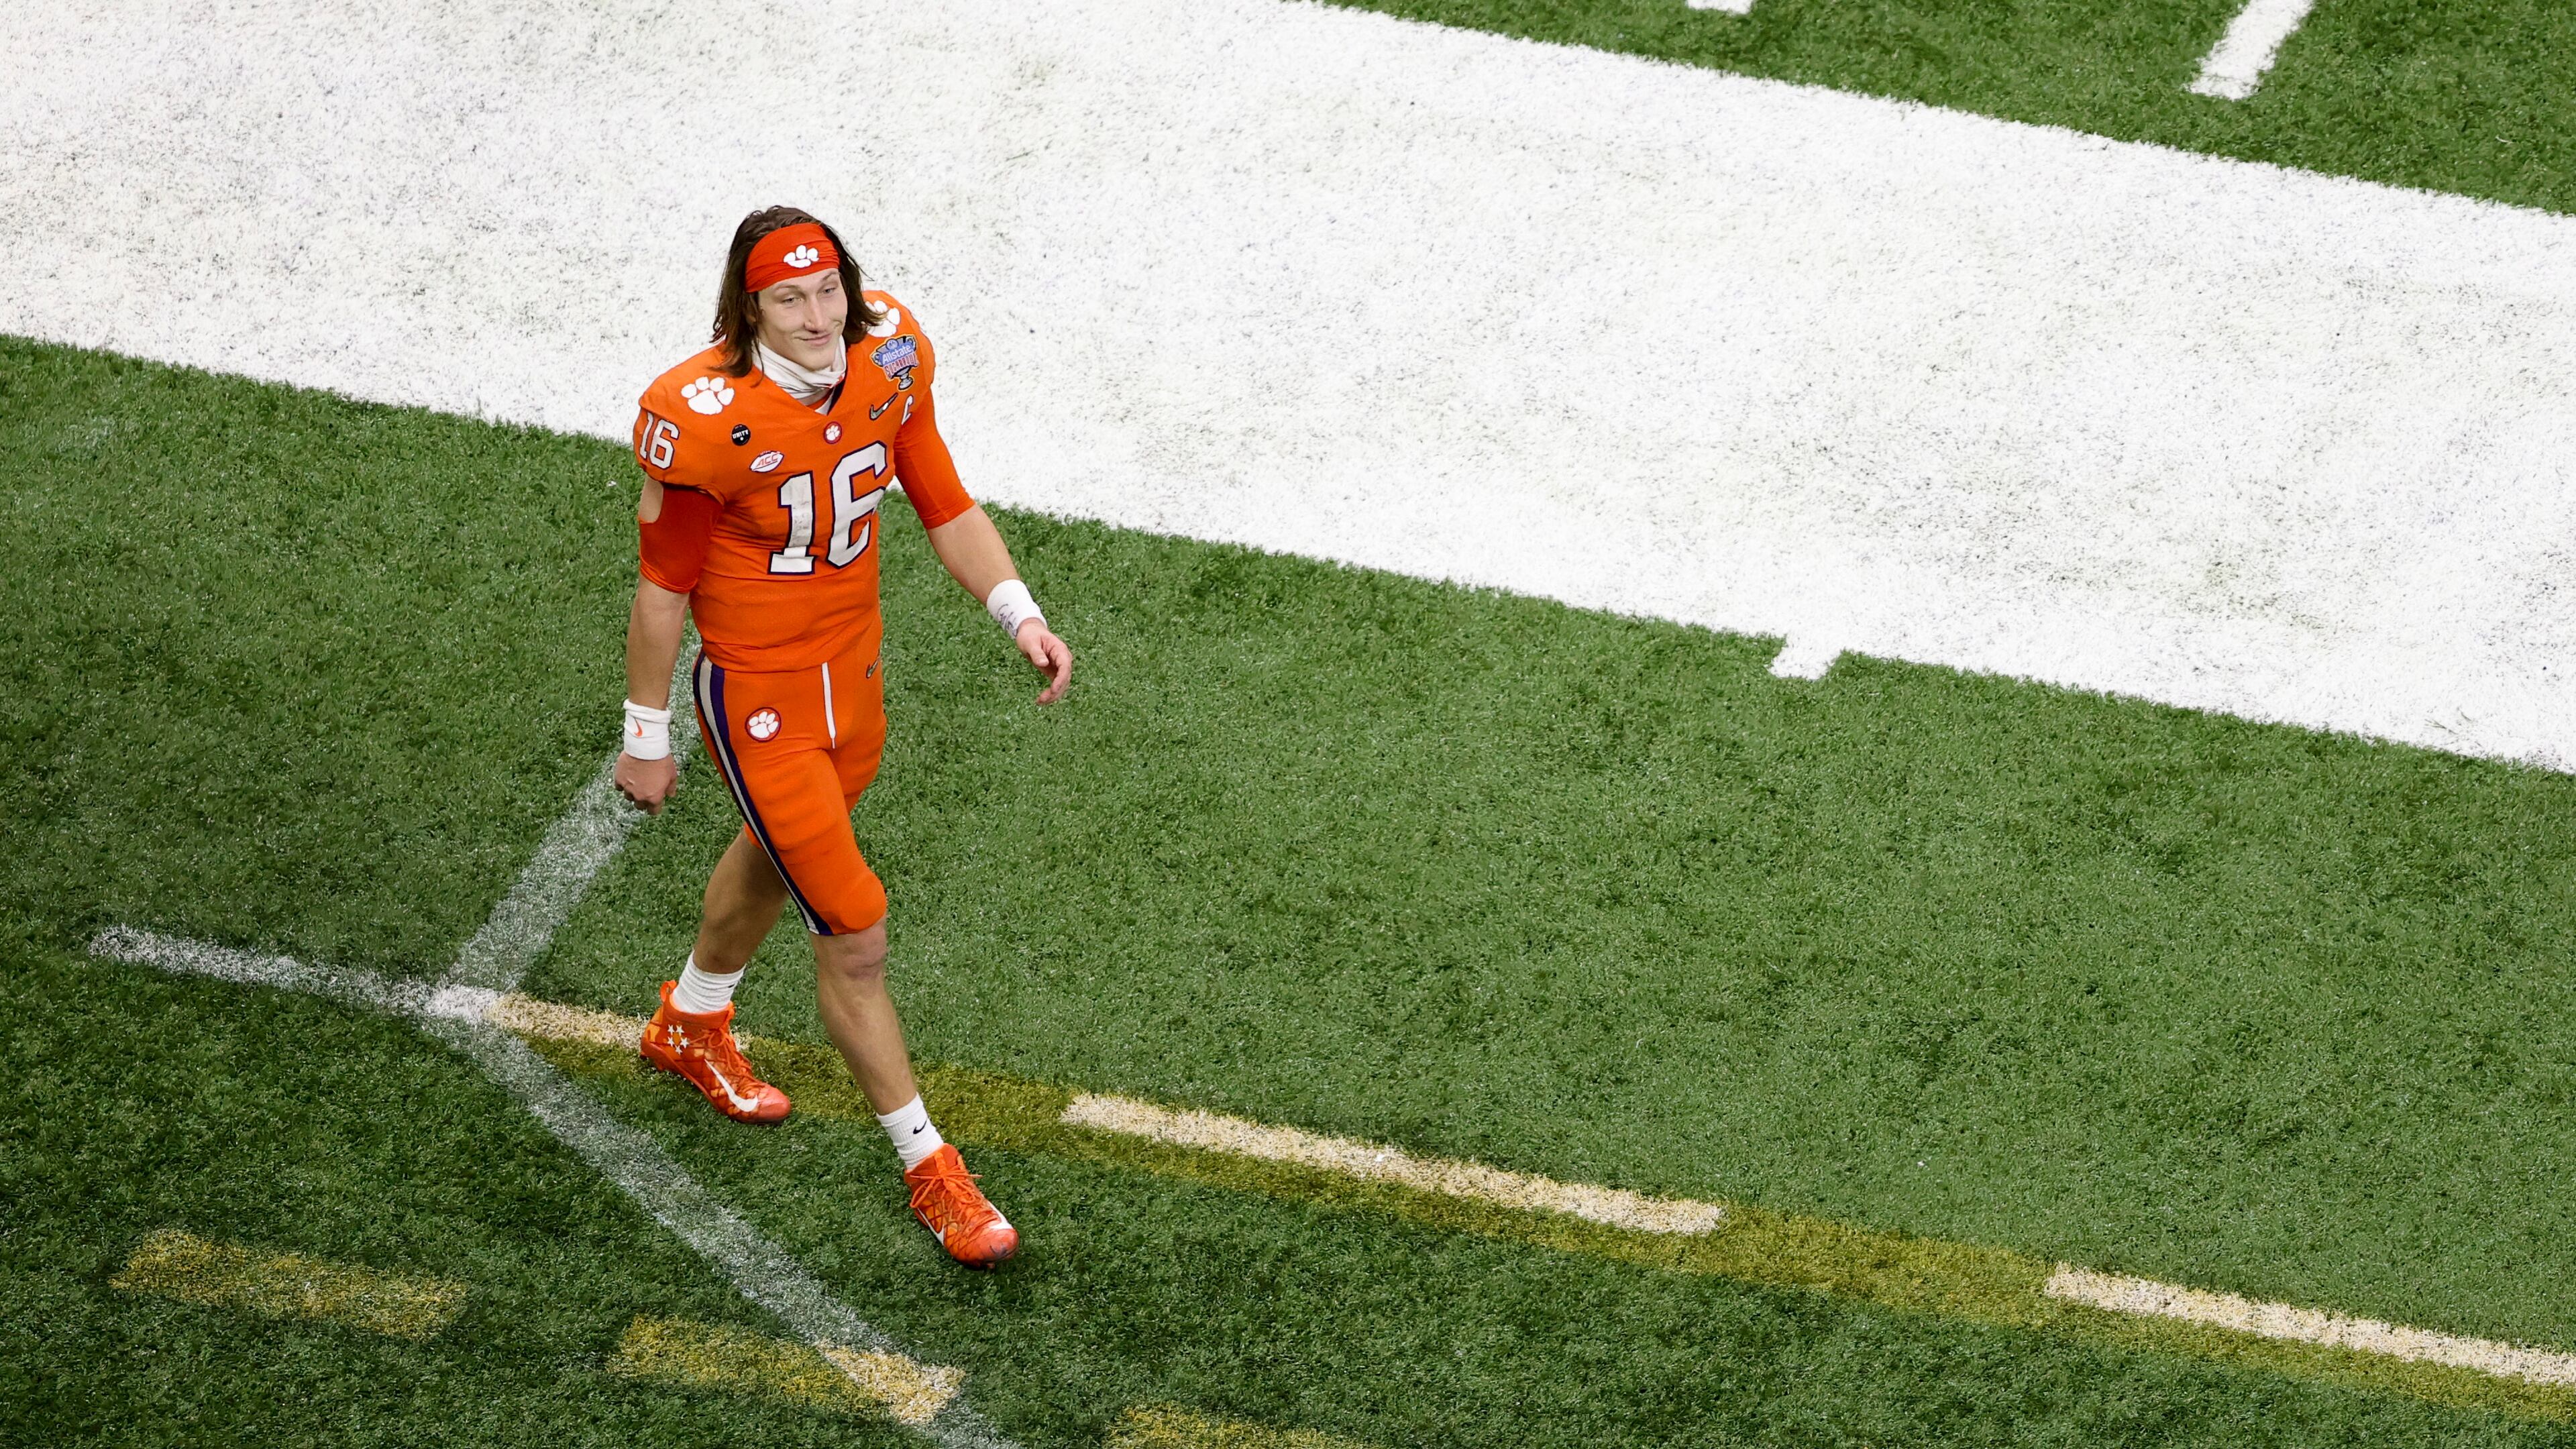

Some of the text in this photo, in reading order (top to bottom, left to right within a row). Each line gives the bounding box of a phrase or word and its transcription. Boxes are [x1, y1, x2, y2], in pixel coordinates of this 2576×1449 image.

[882, 345, 912, 364] Allstate
[884, 358, 904, 378] SUGAR
[639, 411, 680, 470] 16
[732, 429, 749, 439] UNITY
[756, 453, 779, 468] ACC
[768, 440, 888, 576] 16
